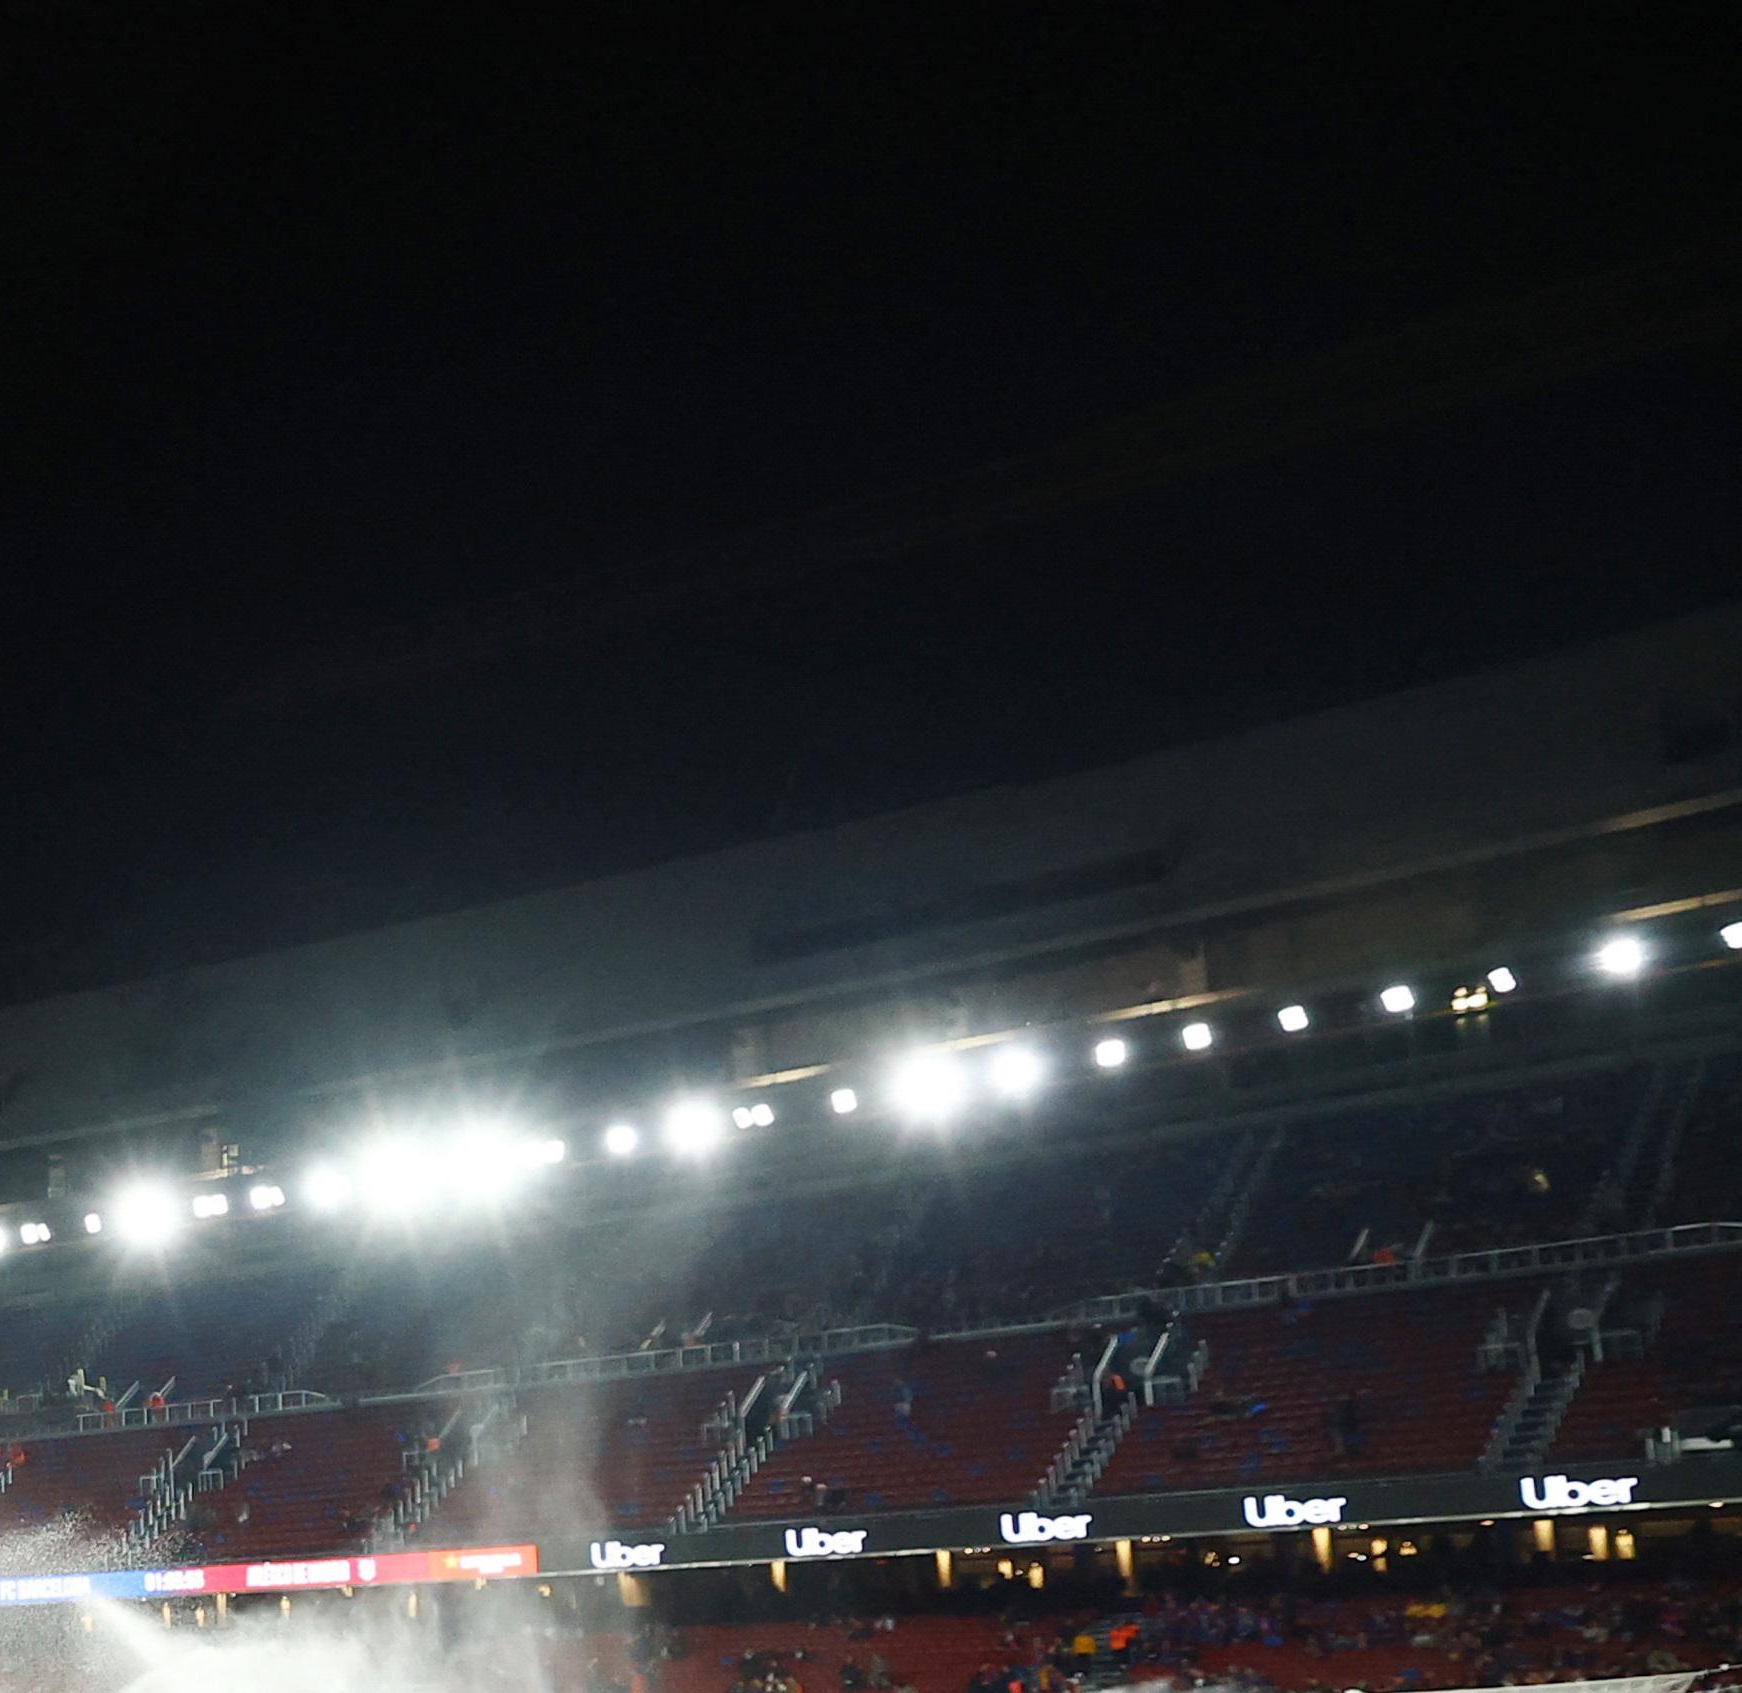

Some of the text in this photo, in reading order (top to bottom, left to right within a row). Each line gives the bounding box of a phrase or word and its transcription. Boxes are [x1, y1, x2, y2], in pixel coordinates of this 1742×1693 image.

[1520, 1475, 1638, 1509] Uber
[1244, 1495, 1346, 1527] Uber
[785, 1528, 866, 1556] Uber
[1001, 1512, 1092, 1543] Uber
[590, 1541, 664, 1568] Uber
[0, 1581, 16, 1600] FC
